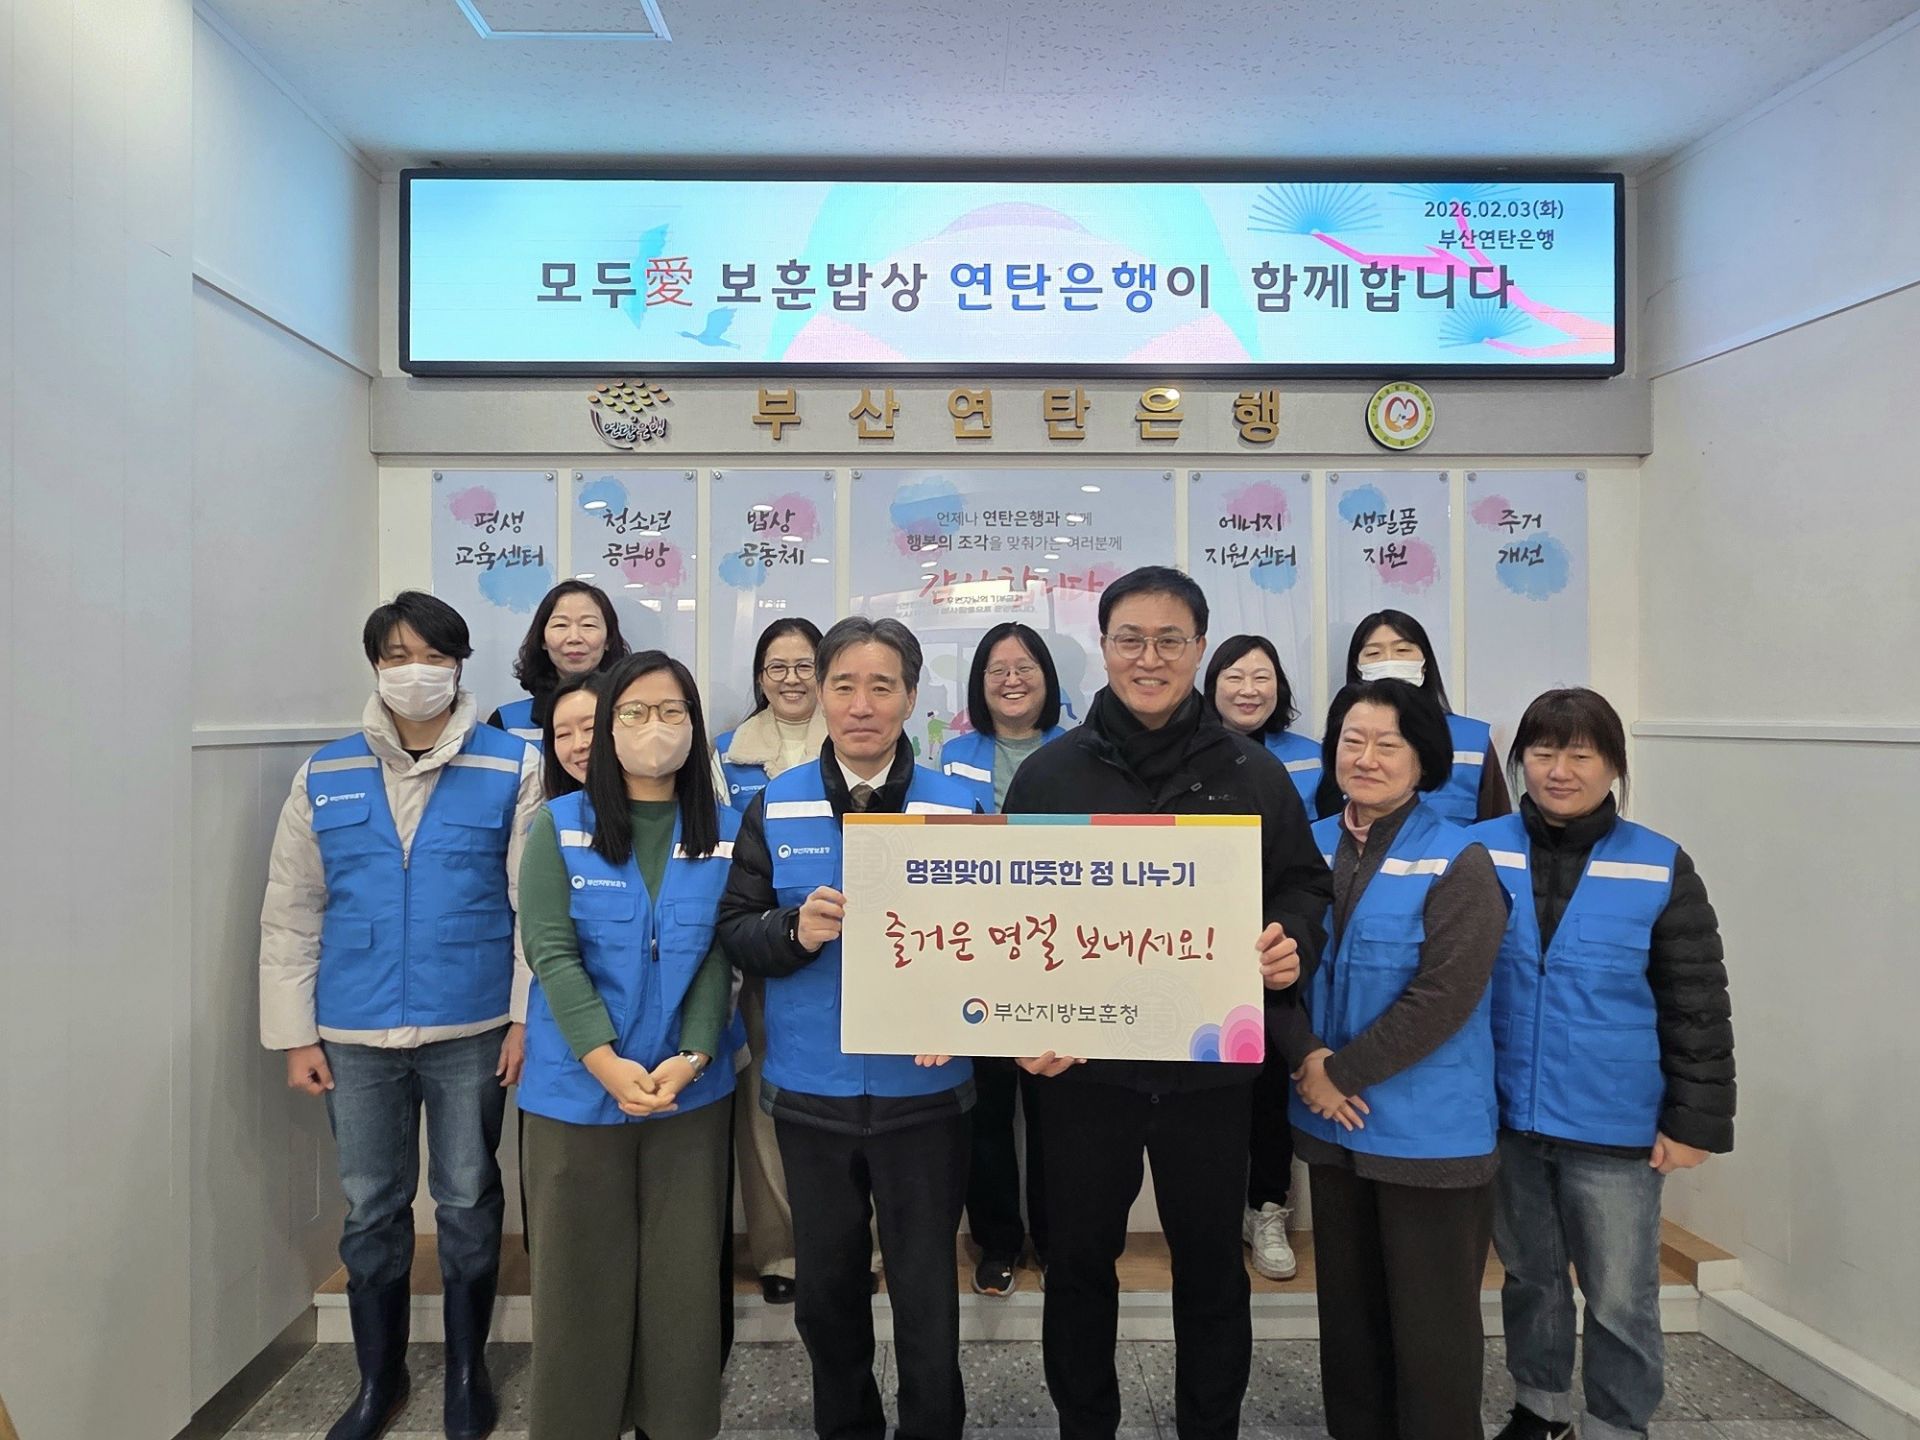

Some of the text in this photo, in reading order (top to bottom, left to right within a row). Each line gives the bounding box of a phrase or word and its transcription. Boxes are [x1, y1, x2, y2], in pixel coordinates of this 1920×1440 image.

[1424, 198, 1564, 221] 2026.02.03(화)
[1438, 228, 1555, 251] 부산연탄은행
[716, 258, 928, 313] 보훈밥상
[950, 260, 1212, 314] 연탄은행이
[1251, 260, 1516, 313] 함께합니다
[604, 415, 667, 442] 연탄은행
[474, 510, 525, 534] 평생
[603, 508, 672, 534] 청소년
[746, 508, 796, 533] 밥상
[936, 511, 978, 527] 언제나
[982, 510, 1061, 528] 연탄은행과
[1218, 511, 1282, 533] 에너지
[1352, 507, 1419, 535] 생필품
[1497, 508, 1542, 534] 주거
[602, 542, 670, 568] 공부방
[738, 542, 805, 567] 공동체
[907, 534, 952, 552] 행복의
[957, 534, 1002, 551] 조각을
[1066, 535, 1122, 551] 여러분께
[1497, 544, 1545, 566] 개선
[455, 543, 545, 569] 교육센터
[1205, 544, 1297, 568] 지원센터
[1363, 544, 1408, 568] 지원
[906, 859, 1196, 888] 명절맞이 따뜻한 정 나누기
[885, 911, 1216, 972] 즐거운 명절 보내세요!
[993, 1001, 1139, 1025] 부산지방보훈청
